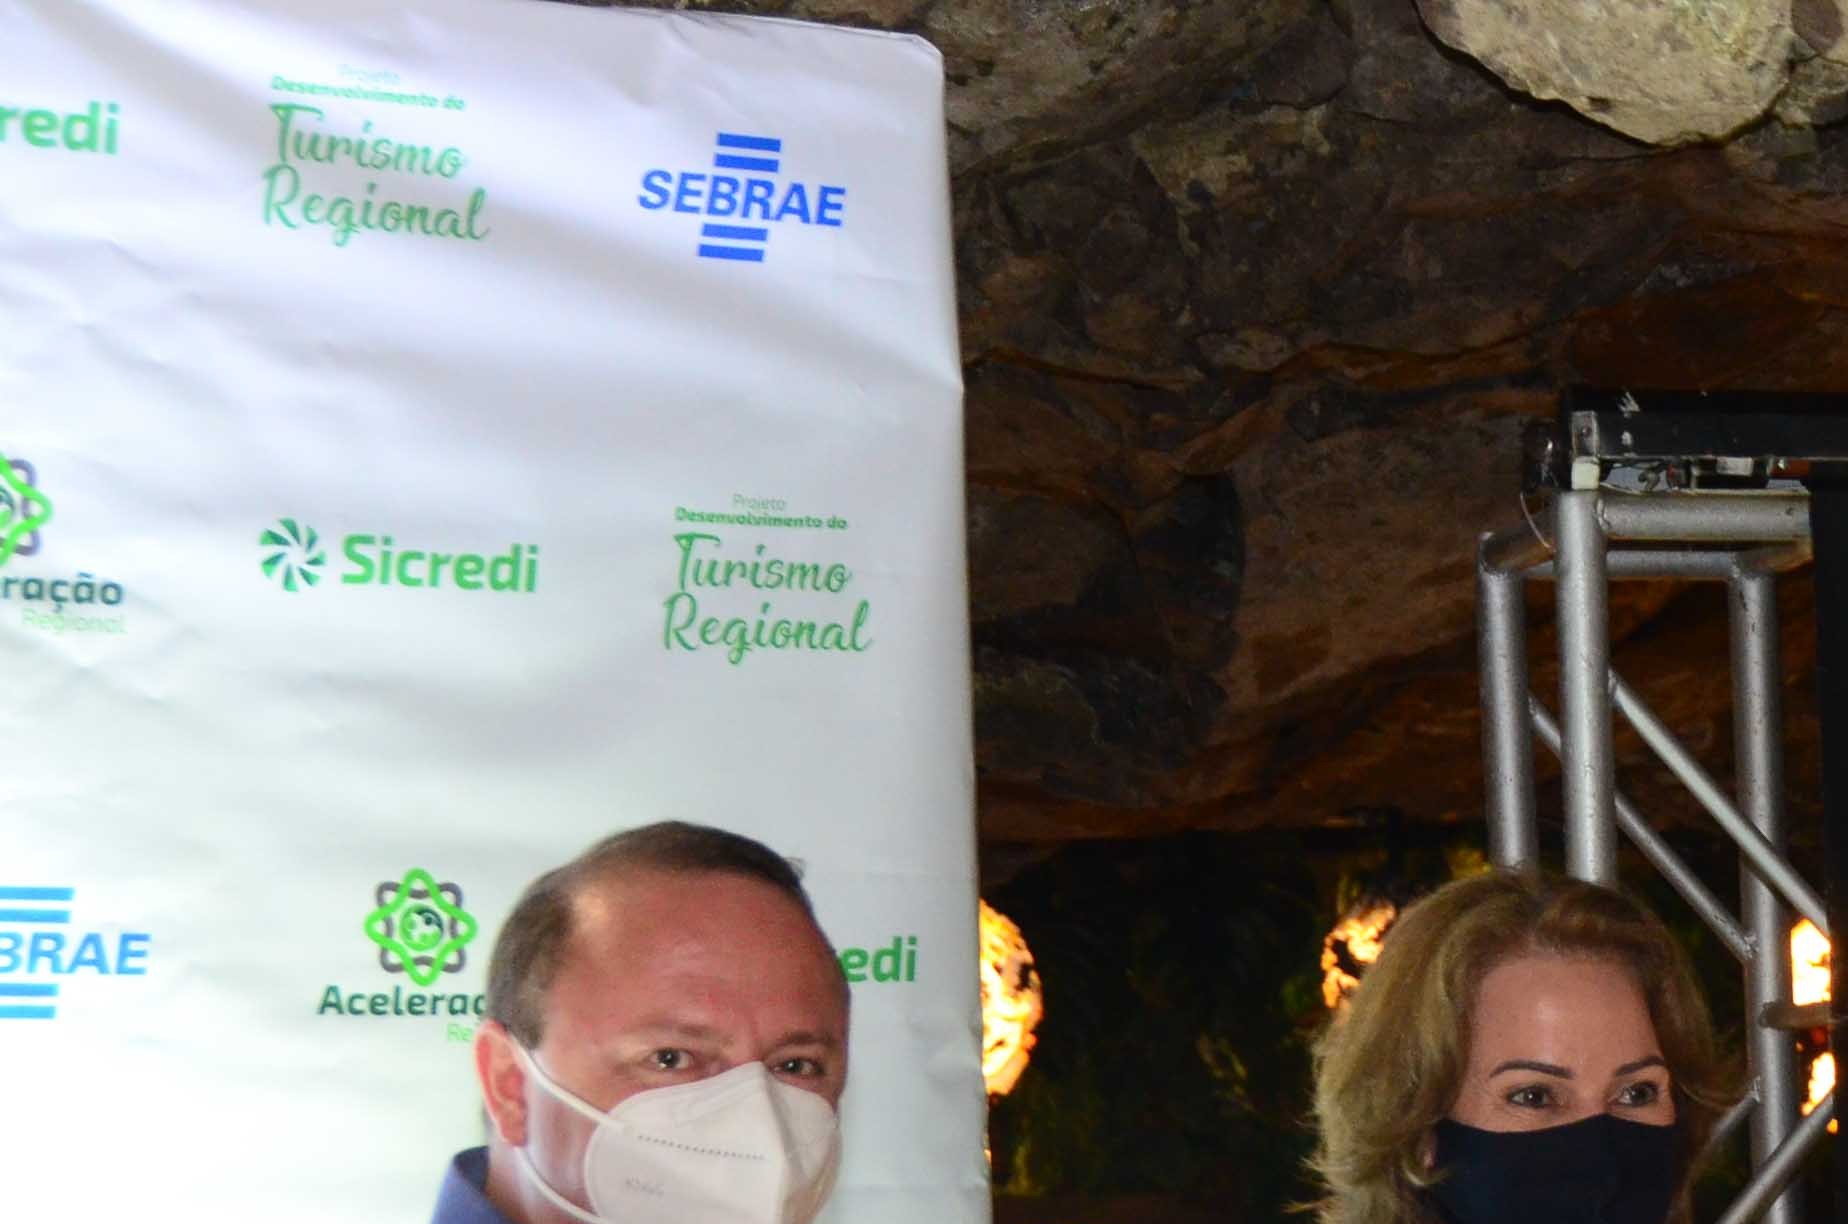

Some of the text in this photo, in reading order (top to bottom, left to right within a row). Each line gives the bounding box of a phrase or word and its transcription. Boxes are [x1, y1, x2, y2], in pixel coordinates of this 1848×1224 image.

[269, 102, 467, 179] Turismo
[263, 163, 491, 248] Regional
[637, 169, 846, 226] SEBRAE
[675, 506, 848, 529] Desenvolvimento do
[0, 572, 123, 613] ração
[340, 533, 539, 592] Sicredi
[673, 532, 853, 593] Turismo
[662, 591, 874, 665] Regional
